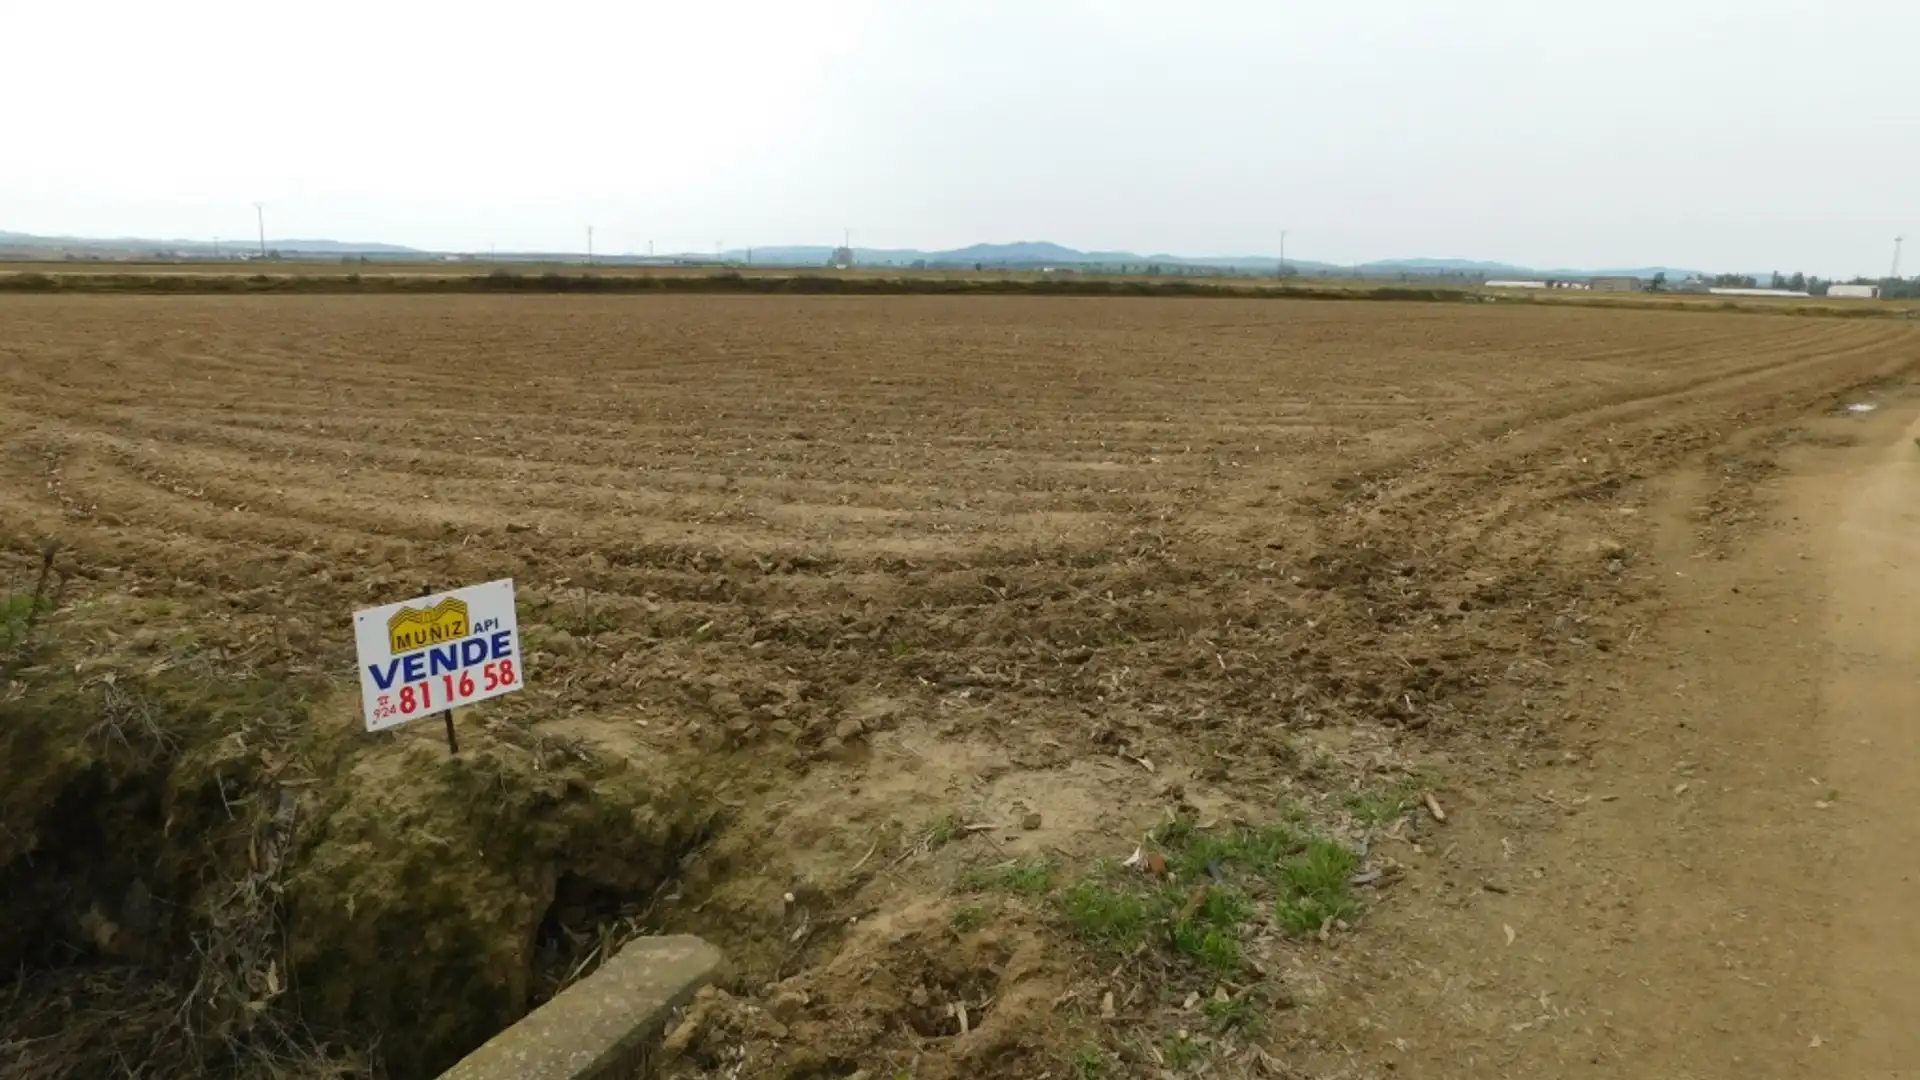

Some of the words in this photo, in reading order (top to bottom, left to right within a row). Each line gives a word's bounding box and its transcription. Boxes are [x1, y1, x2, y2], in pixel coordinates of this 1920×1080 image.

[368, 630, 512, 691] VENDE
[397, 621, 463, 649] MUÑIZ
[473, 617, 499, 635] API
[373, 704, 397, 721] 924
[399, 681, 431, 714] 81
[442, 670, 475, 702] 16
[483, 659, 515, 691] 58
